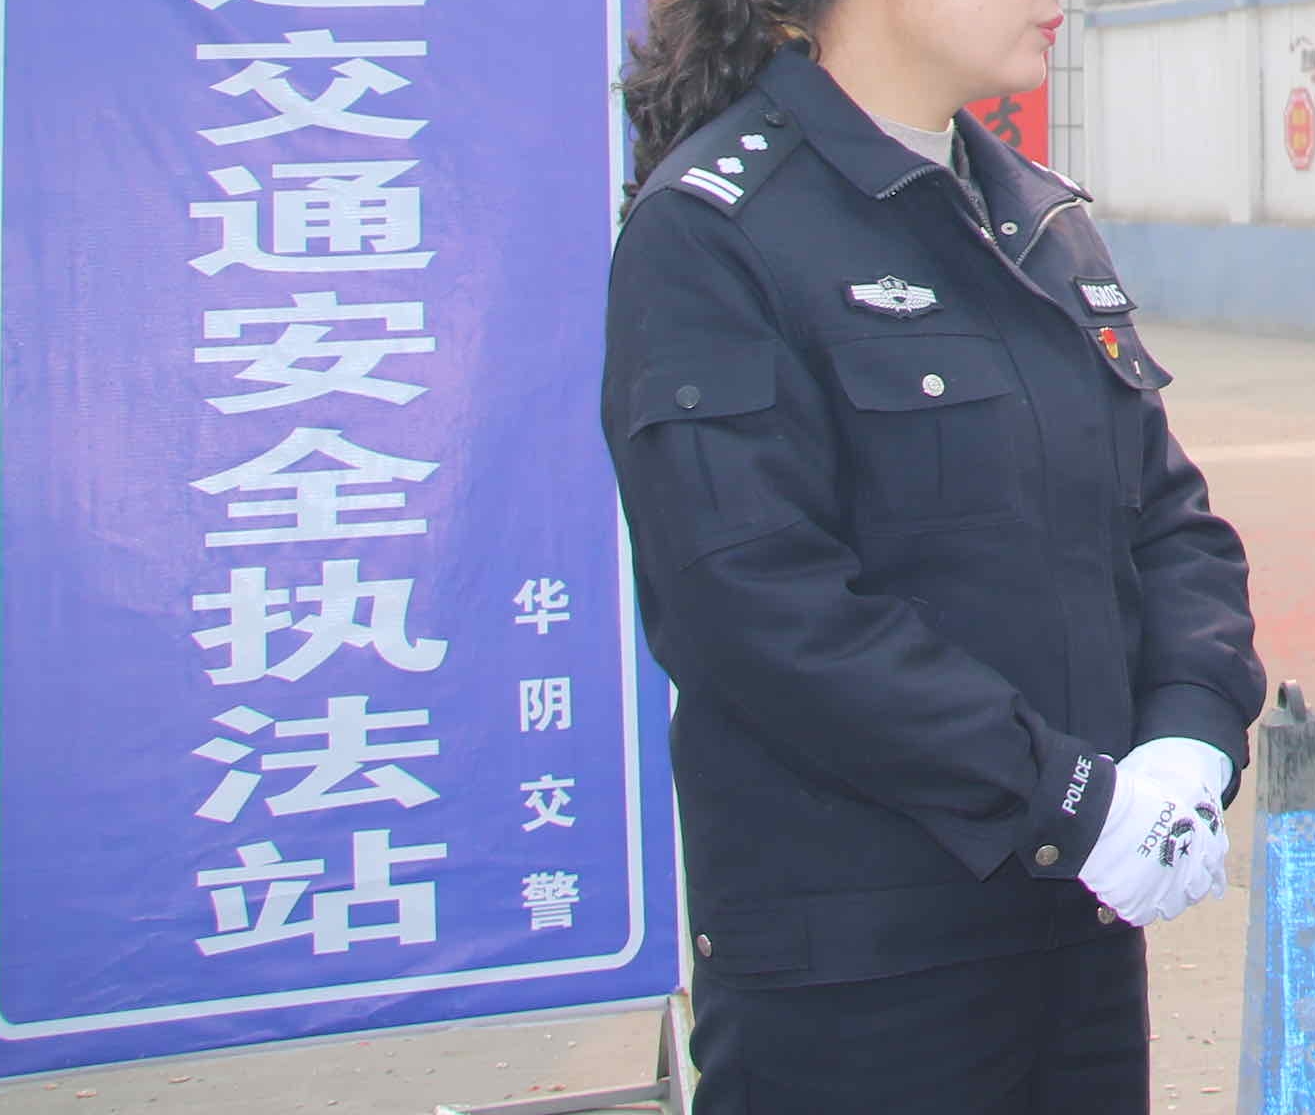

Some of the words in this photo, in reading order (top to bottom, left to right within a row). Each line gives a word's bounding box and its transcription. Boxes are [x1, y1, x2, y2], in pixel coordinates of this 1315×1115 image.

[513, 577, 581, 931] 华阴交警
[1062, 755, 1092, 815] POLICE
[1137, 801, 1176, 858] POLICE
